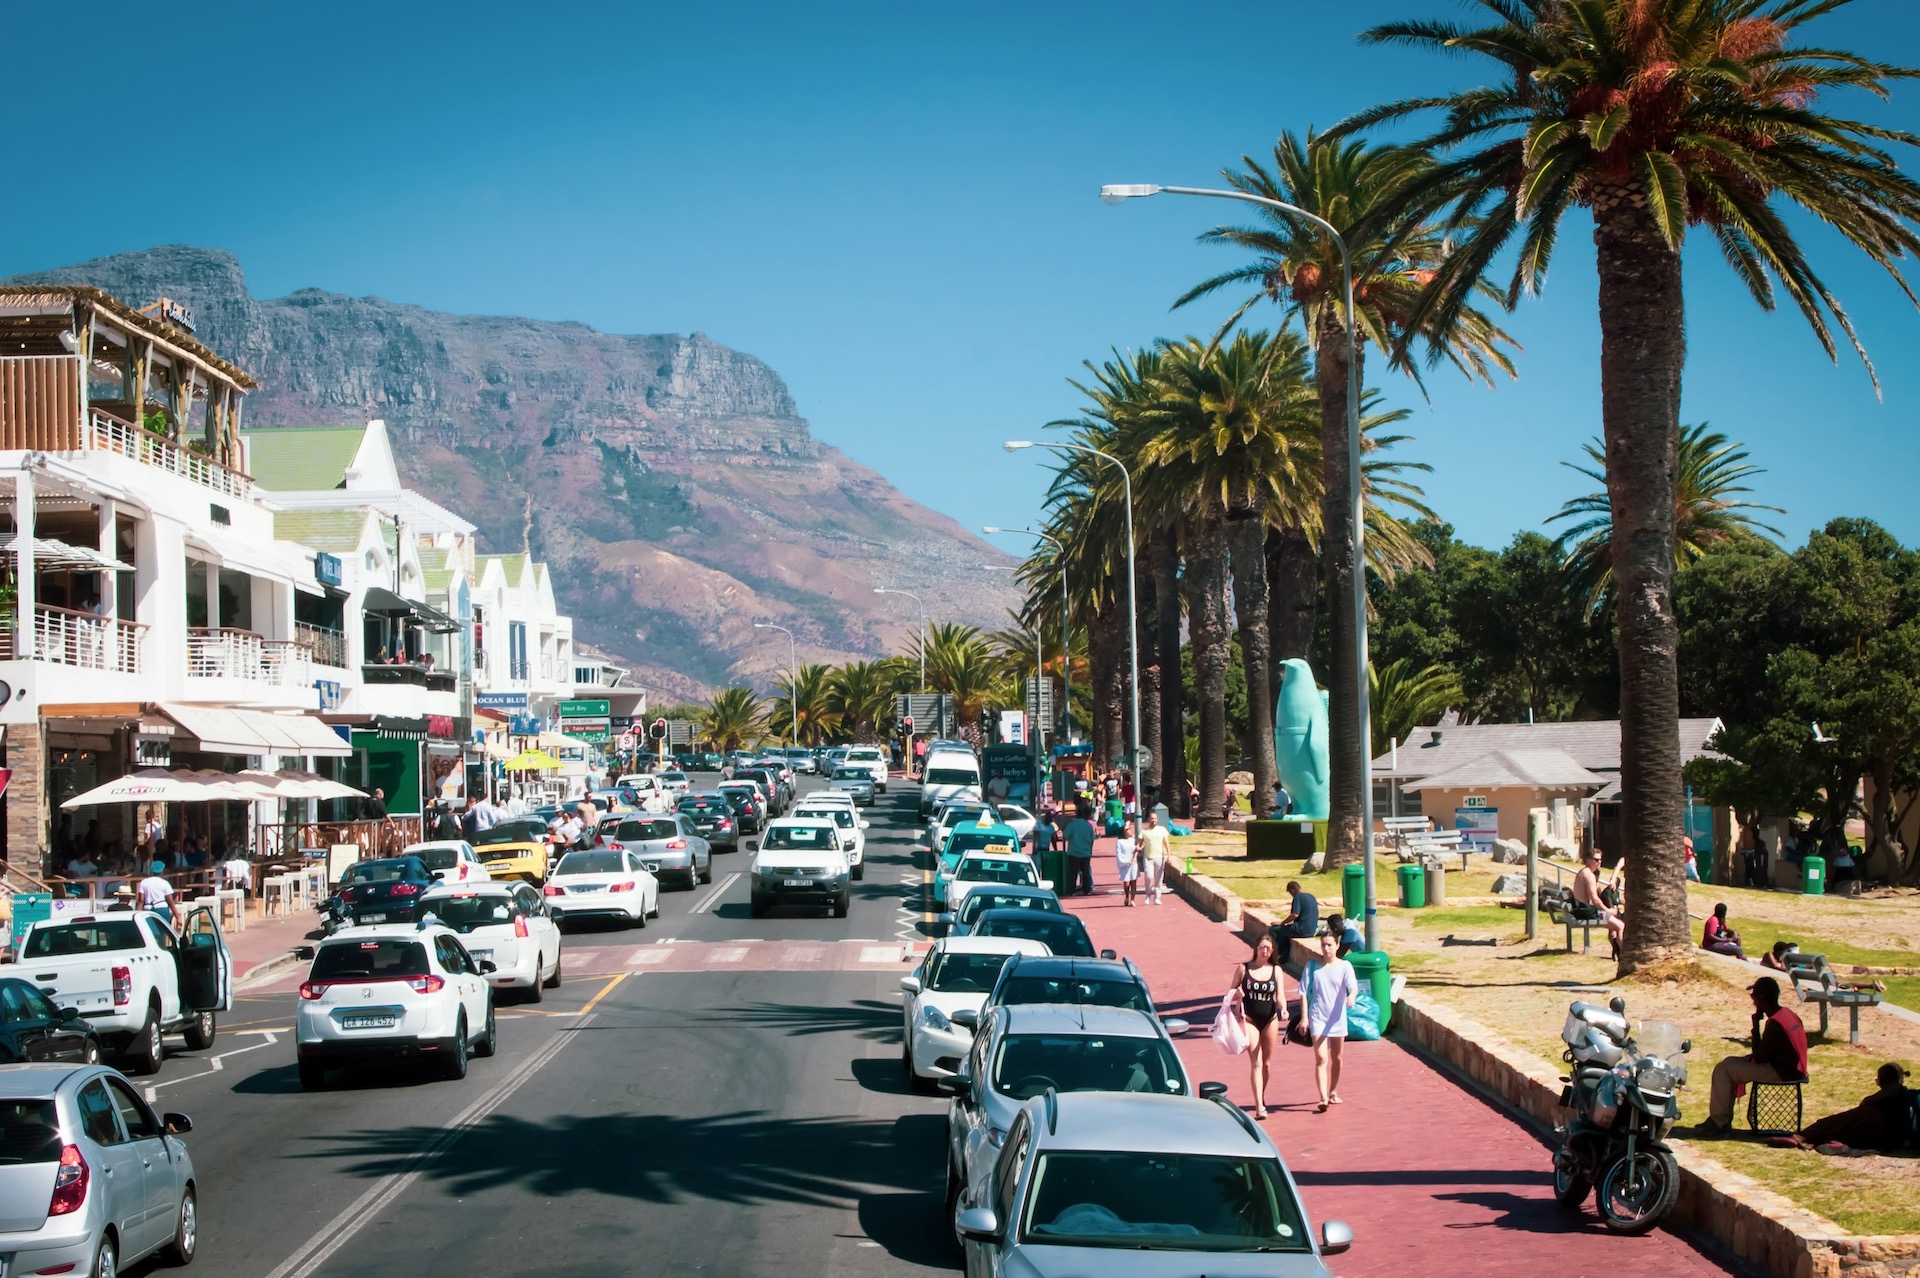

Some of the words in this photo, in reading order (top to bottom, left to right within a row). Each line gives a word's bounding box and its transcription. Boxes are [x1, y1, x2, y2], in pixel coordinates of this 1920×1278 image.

[991, 768, 1026, 777] Sheby's
[1247, 979, 1274, 991] GOOD
[346, 1018, 357, 1027] CA
